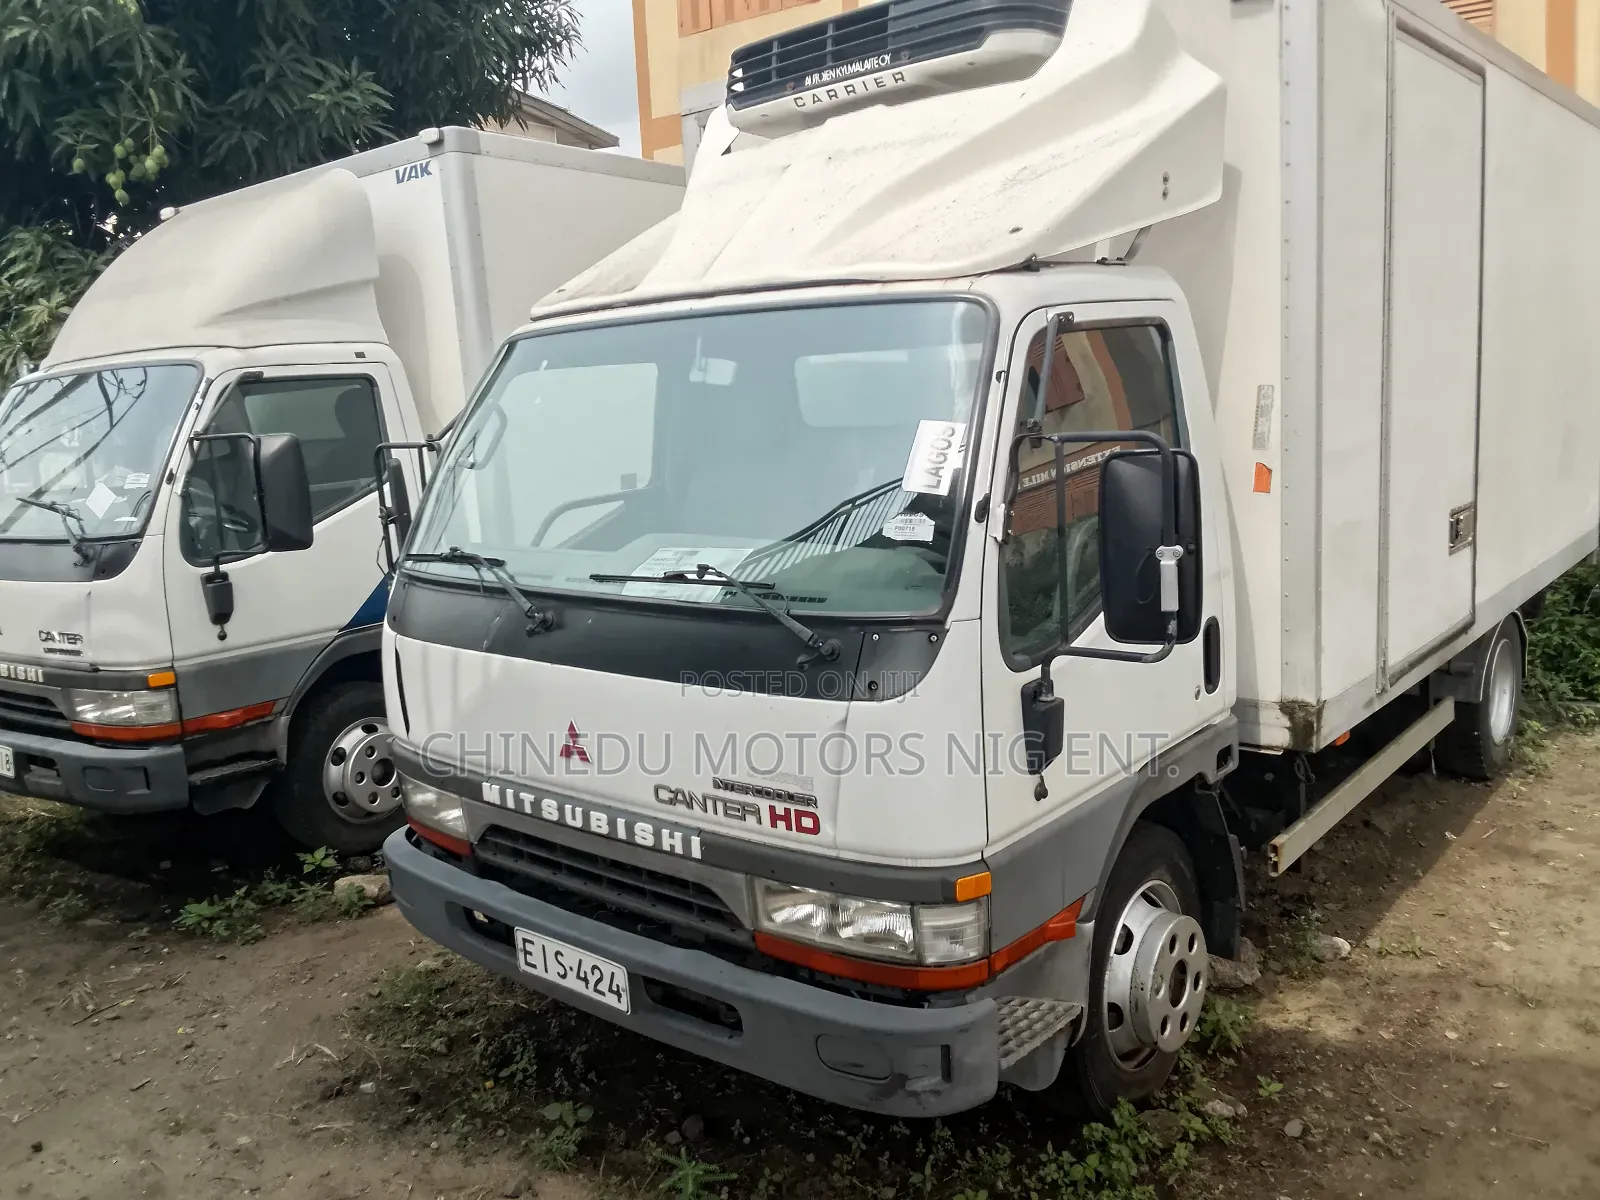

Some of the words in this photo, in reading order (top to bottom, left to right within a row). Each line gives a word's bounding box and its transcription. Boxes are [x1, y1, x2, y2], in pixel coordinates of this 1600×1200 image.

[878, 53, 892, 66] OY
[793, 71, 906, 108] CARRIER
[395, 159, 433, 185] VAK
[924, 425, 956, 490] LAGOS
[38, 629, 84, 646] CANTER
[653, 783, 763, 826] CANTER
[768, 804, 821, 836] HD
[712, 776, 818, 809] INTERCOOLER
[481, 781, 702, 860] MITSUBISHI
